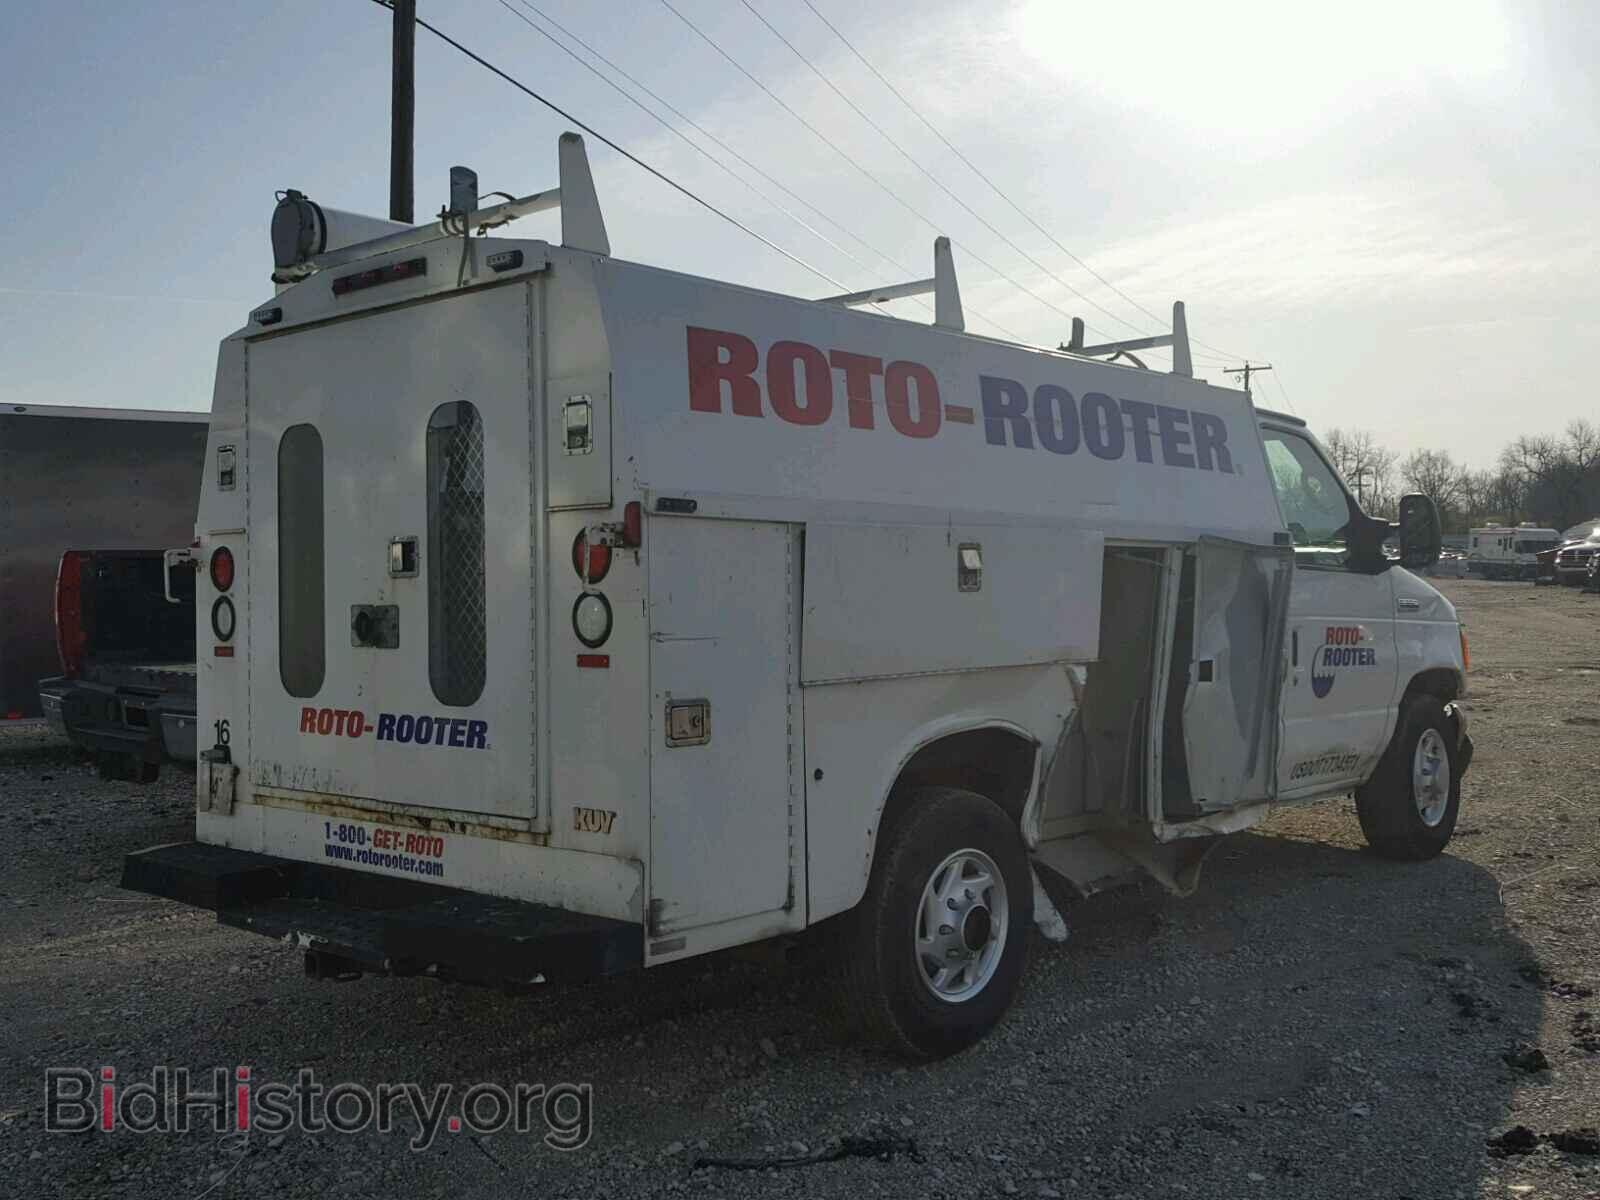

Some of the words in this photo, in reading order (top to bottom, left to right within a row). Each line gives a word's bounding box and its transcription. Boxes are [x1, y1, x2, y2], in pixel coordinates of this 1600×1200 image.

[1322, 647, 1376, 666] ROOTER
[213, 720, 230, 745] 16
[324, 822, 444, 858] 1-800-GET-ROTO
[324, 843, 444, 877] www.rotorooter.com
